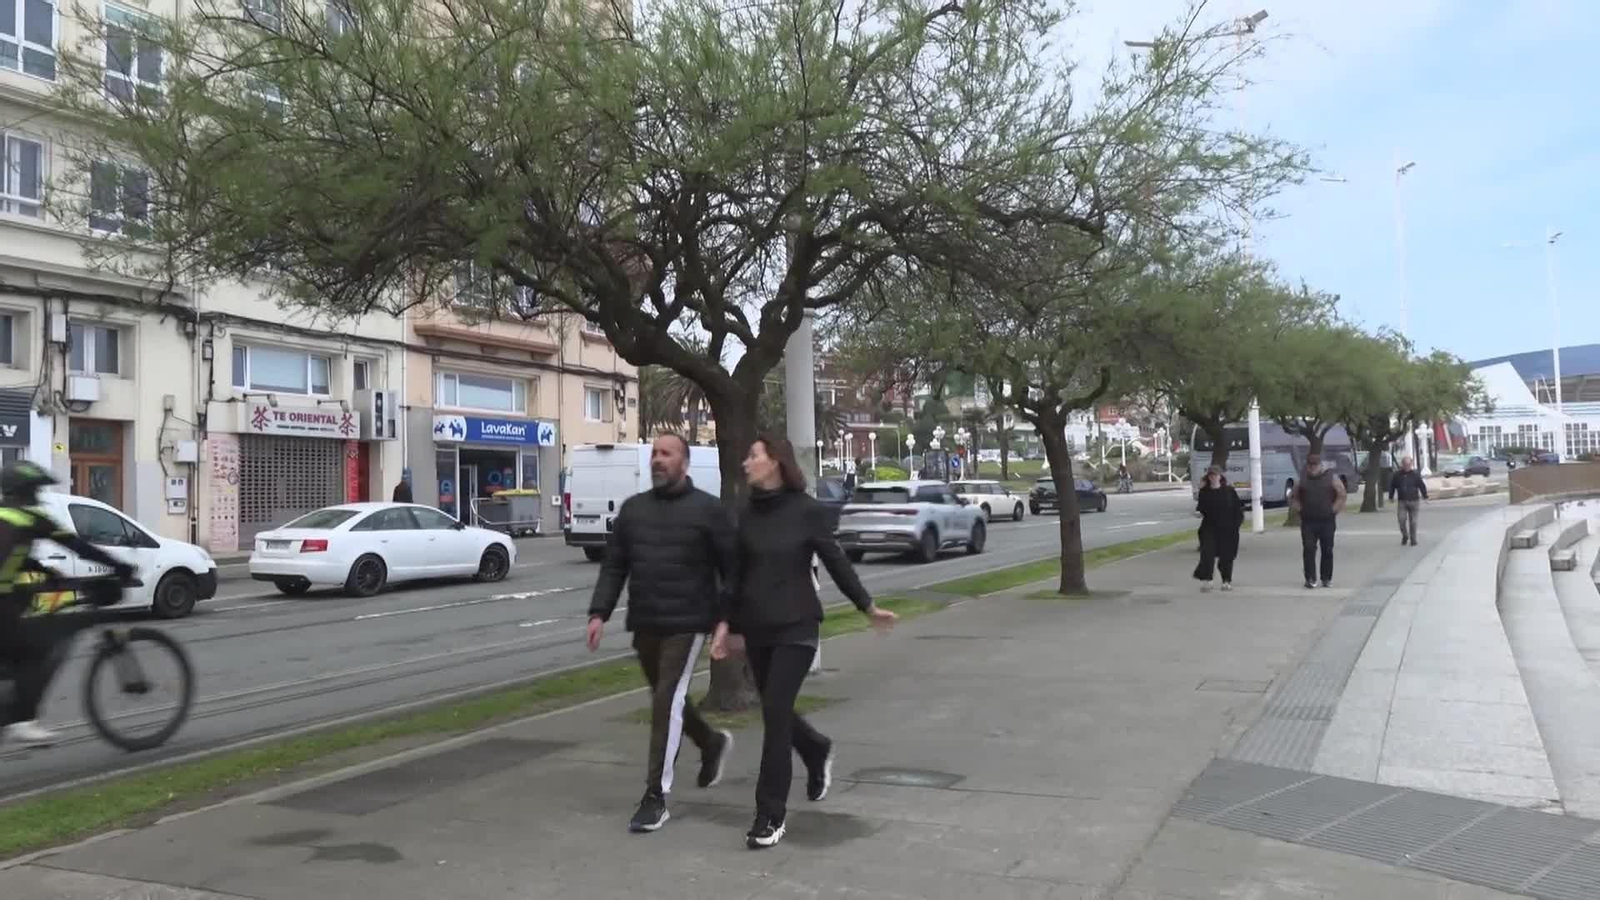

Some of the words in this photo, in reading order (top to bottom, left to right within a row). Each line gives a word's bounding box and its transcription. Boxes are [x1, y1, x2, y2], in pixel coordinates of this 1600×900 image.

[273, 411, 286, 421] TE
[289, 412, 338, 425] ORIENTAL
[481, 421, 526, 436] LavaKan
